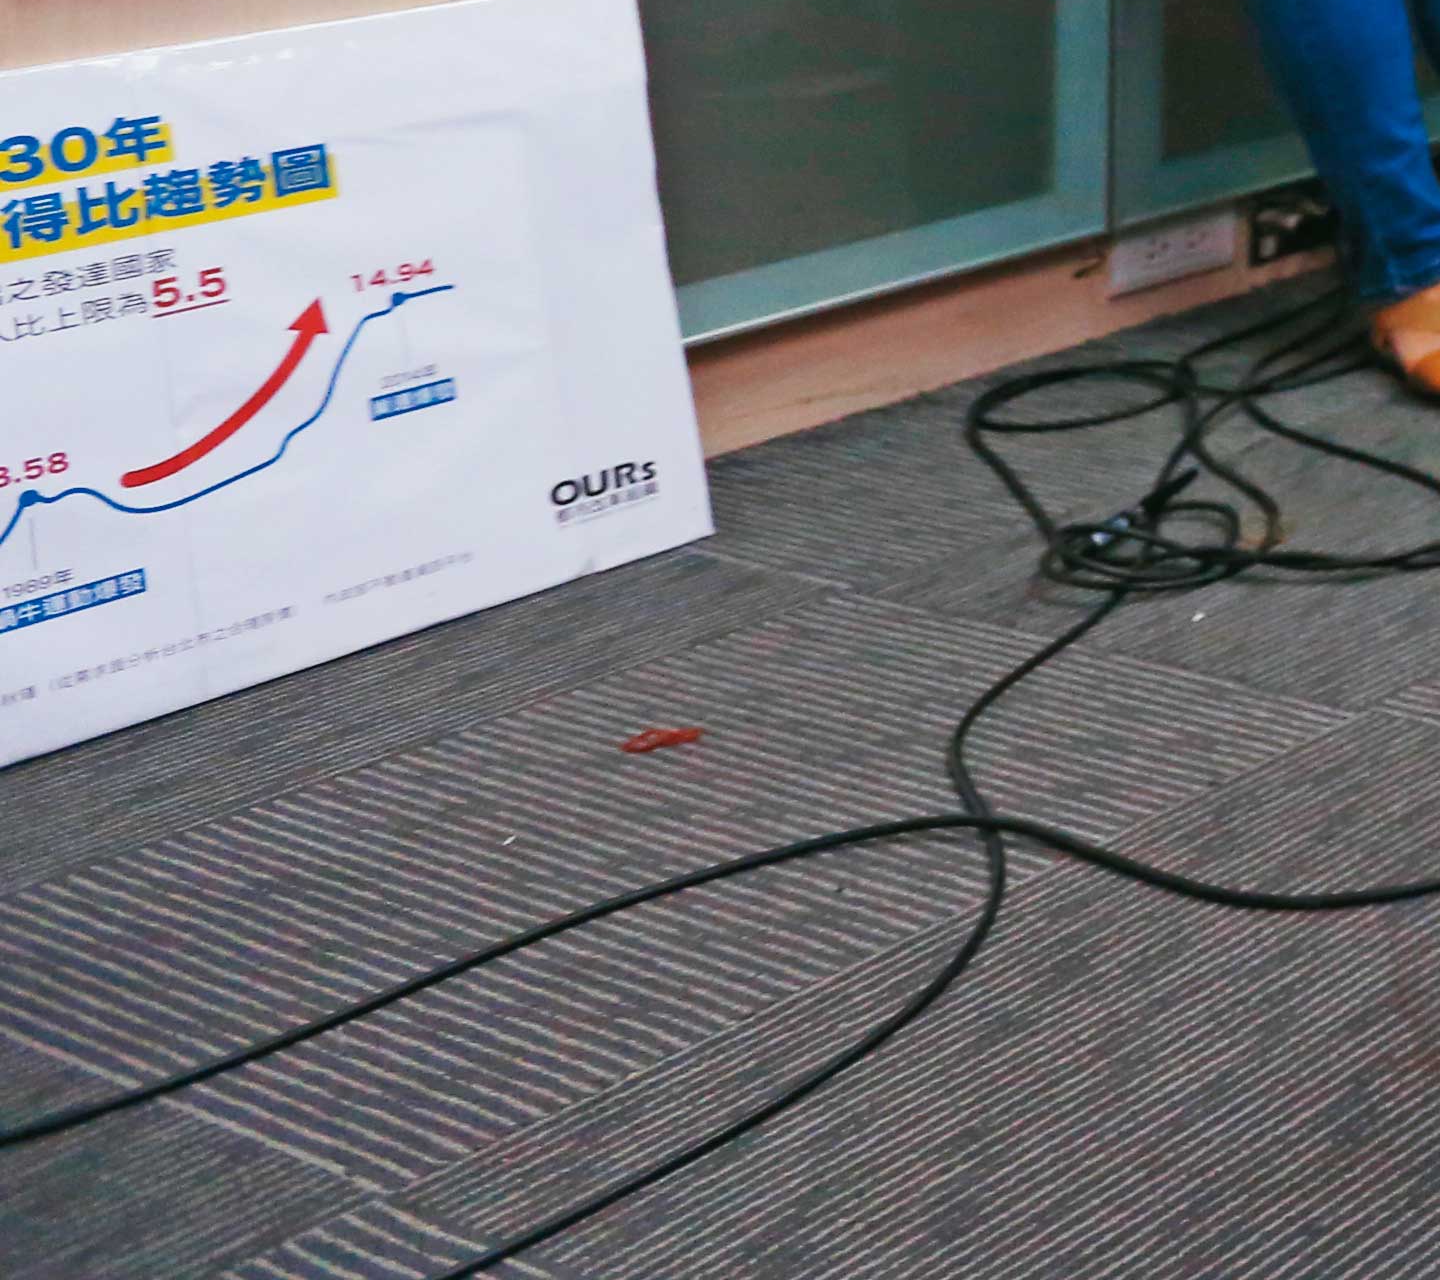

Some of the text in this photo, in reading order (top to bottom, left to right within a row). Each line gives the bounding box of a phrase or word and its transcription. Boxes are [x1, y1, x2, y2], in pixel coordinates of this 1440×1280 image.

[0, 115, 166, 182] 30年
[1, 143, 330, 248] 得比趨勢圖
[0, 248, 178, 305] 之發達國家
[350, 258, 435, 291] 14.94
[550, 460, 657, 506] OURs
